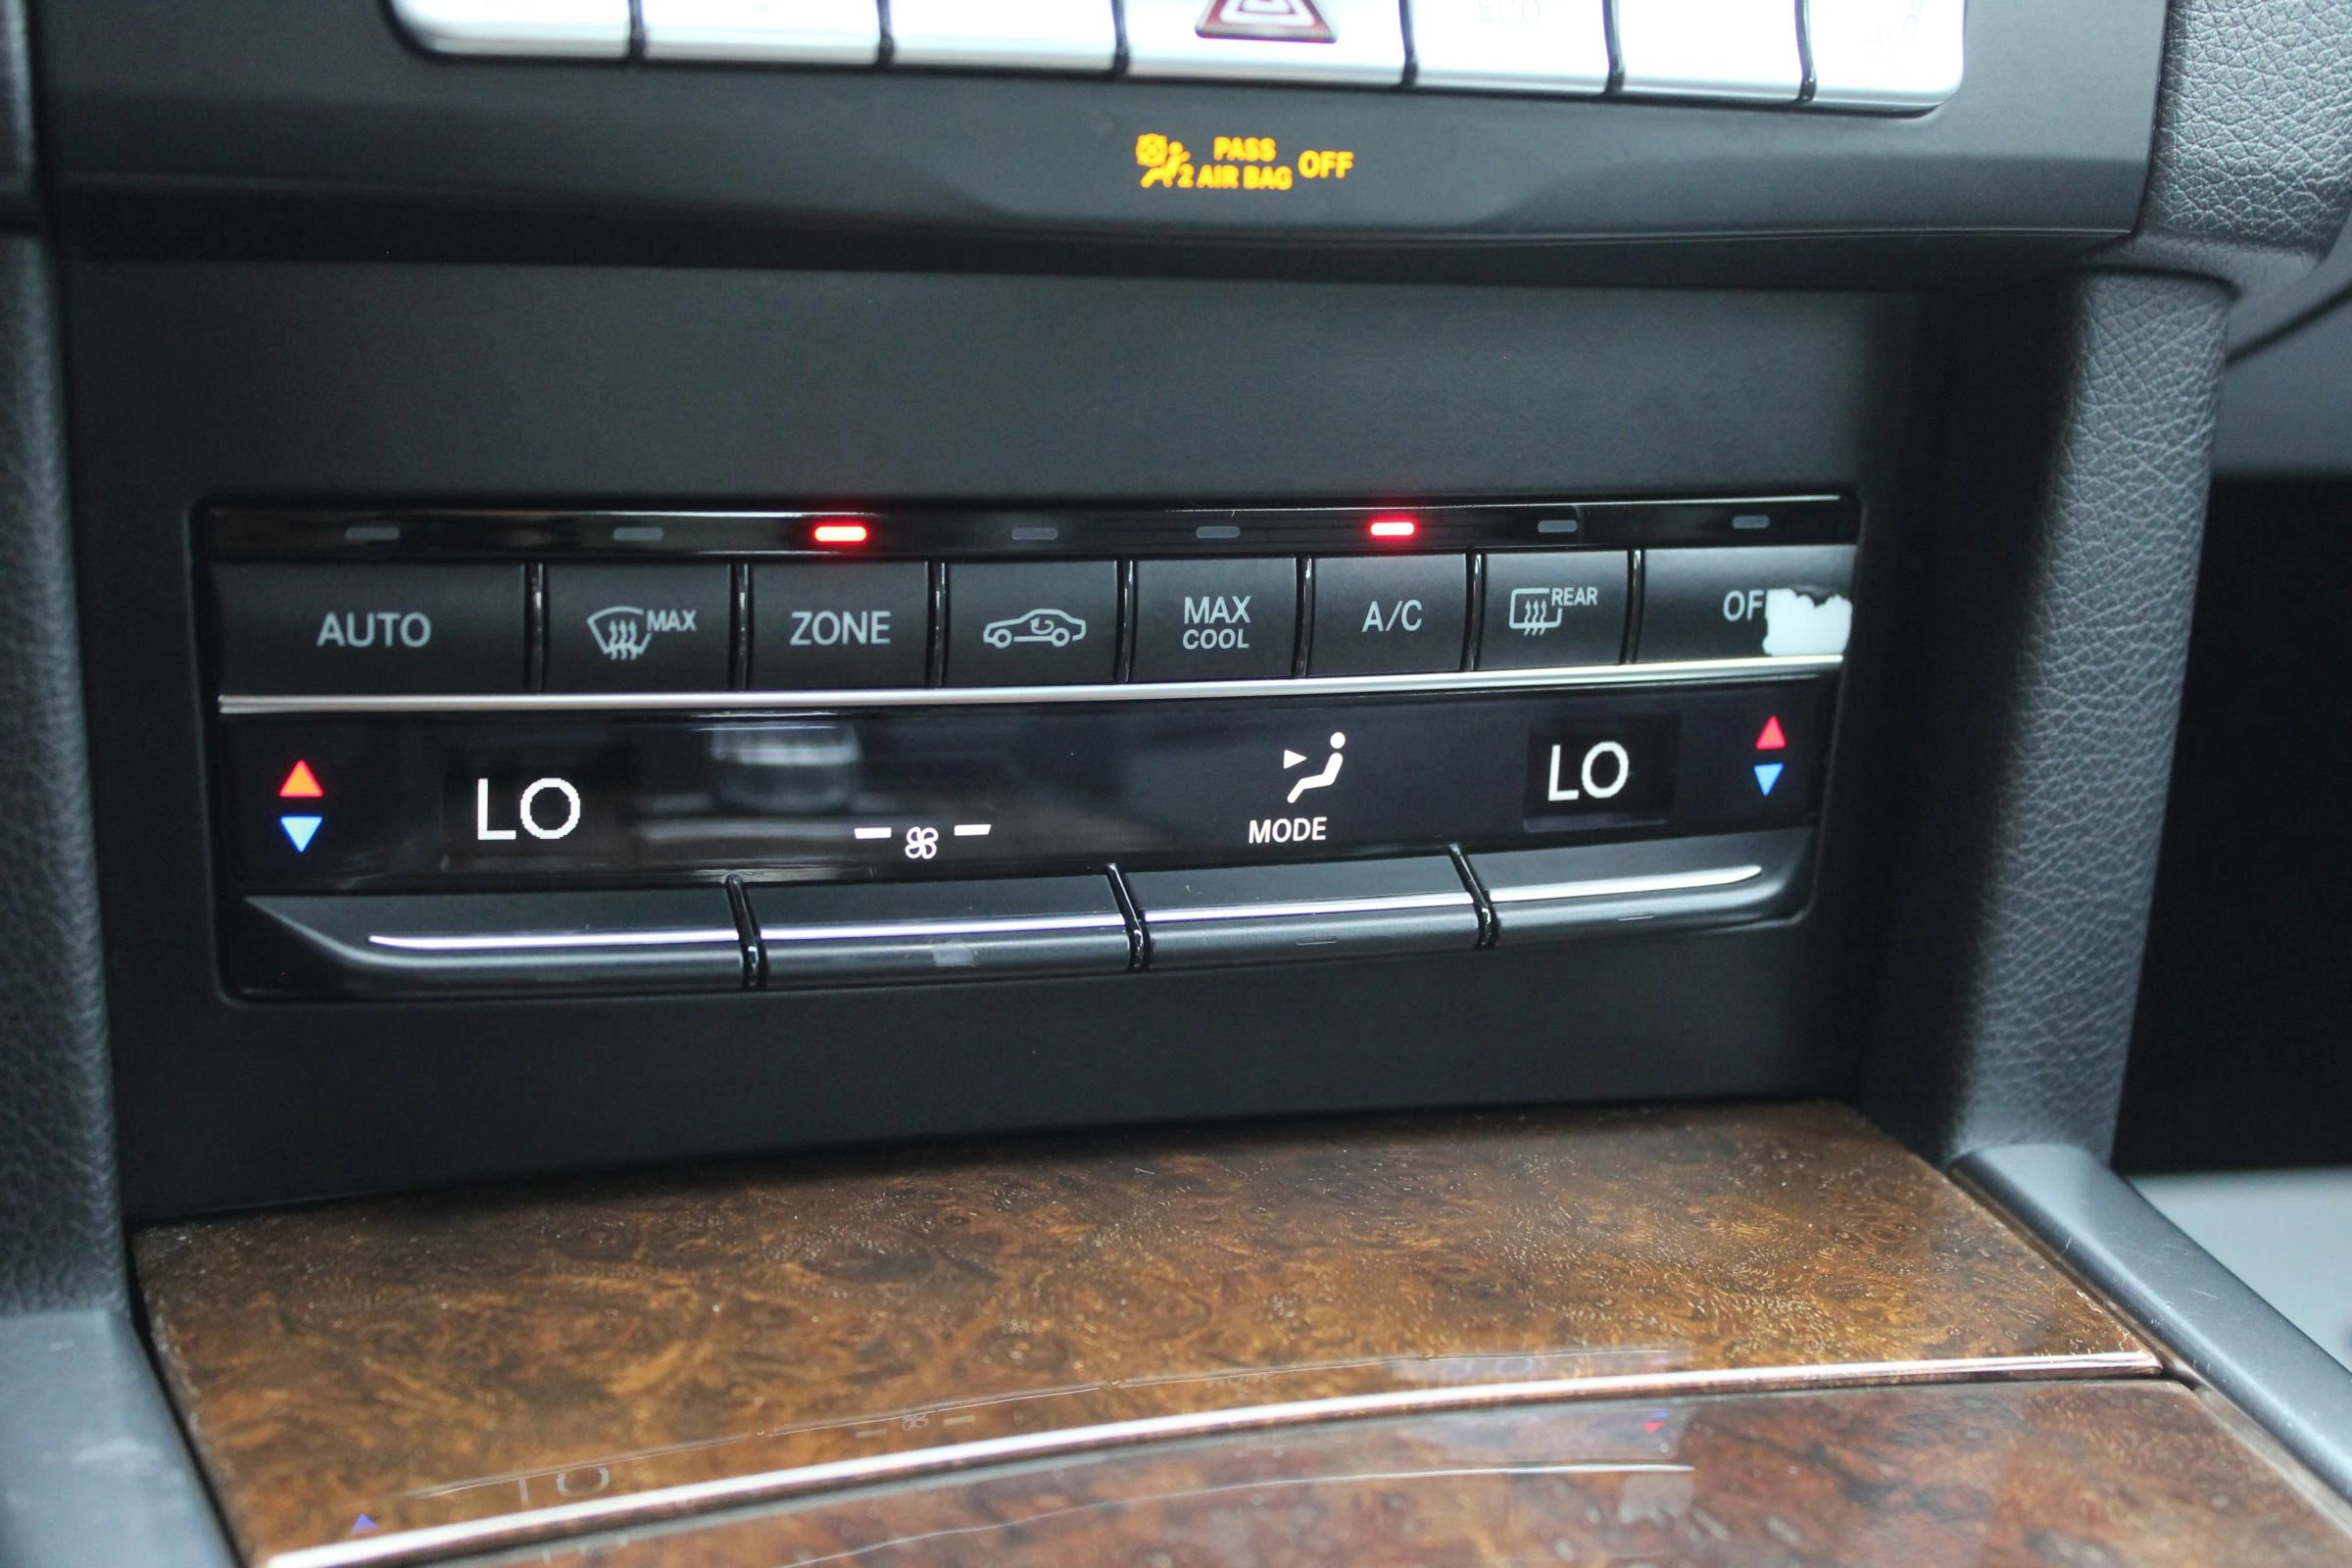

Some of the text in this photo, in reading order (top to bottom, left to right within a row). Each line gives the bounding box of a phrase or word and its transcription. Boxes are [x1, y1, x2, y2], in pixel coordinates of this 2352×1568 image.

[1213, 137, 1277, 162] PASS
[1298, 150, 1354, 178] OFF
[1196, 165, 1293, 190] AIR BAG
[1183, 595, 1252, 625] MAX
[1551, 586, 1598, 607] REAR
[1723, 589, 1769, 622] OF
[317, 612, 432, 648] AUTO
[647, 610, 698, 632] MAX
[790, 611, 892, 646] ZONE
[1360, 599, 1423, 634] A/C
[1182, 628, 1250, 651] COOL
[1547, 740, 1630, 802] LO
[477, 777, 582, 842] LO
[1248, 815, 1329, 845] MODE
